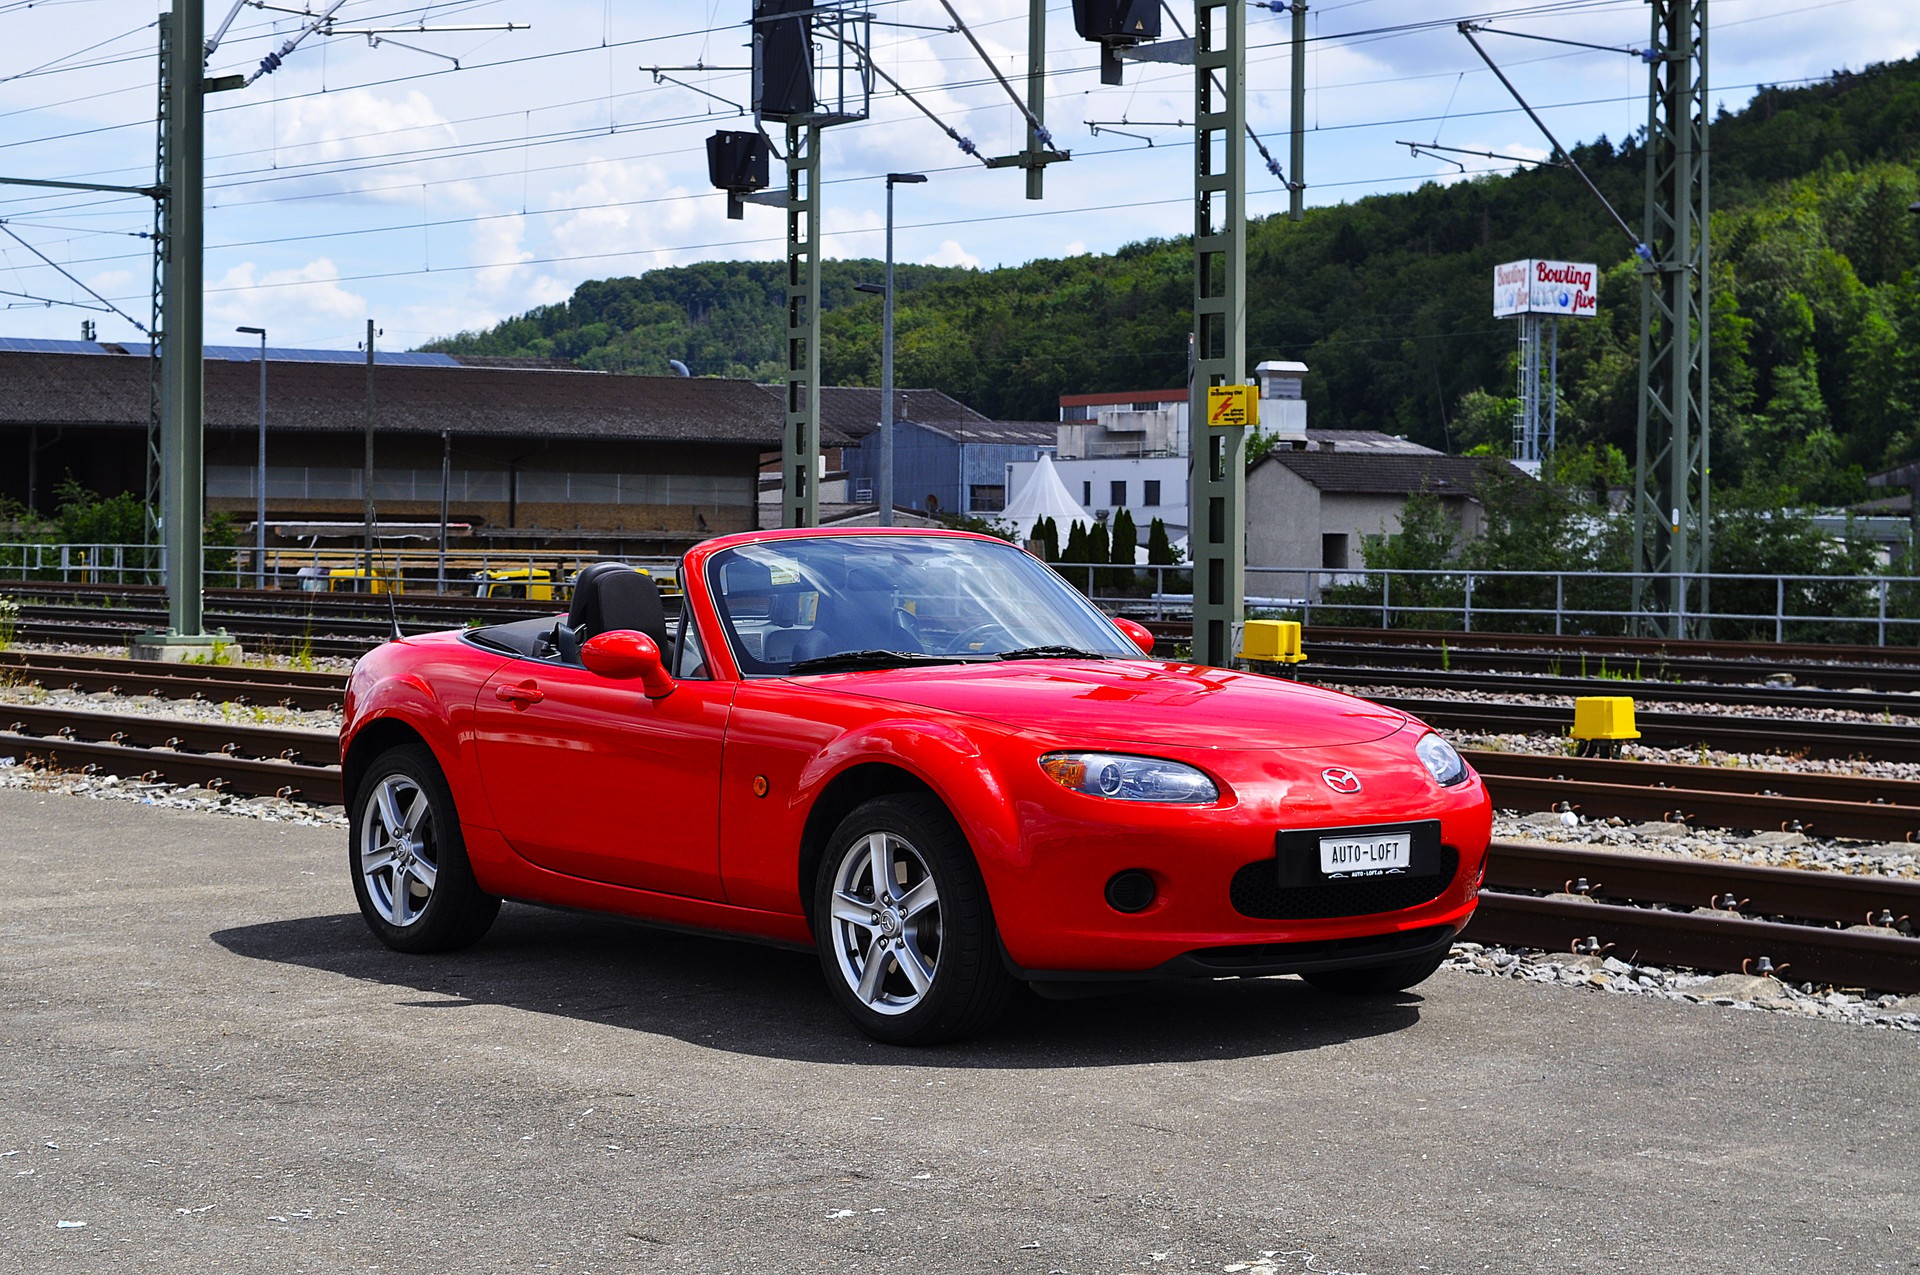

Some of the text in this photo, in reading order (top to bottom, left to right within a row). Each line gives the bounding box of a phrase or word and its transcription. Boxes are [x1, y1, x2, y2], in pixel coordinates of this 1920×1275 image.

[1498, 265, 1525, 287] Bowling
[1537, 262, 1591, 291] Bowling
[1572, 290, 1595, 312] five
[1332, 843, 1398, 864] AUTO-LOFT
